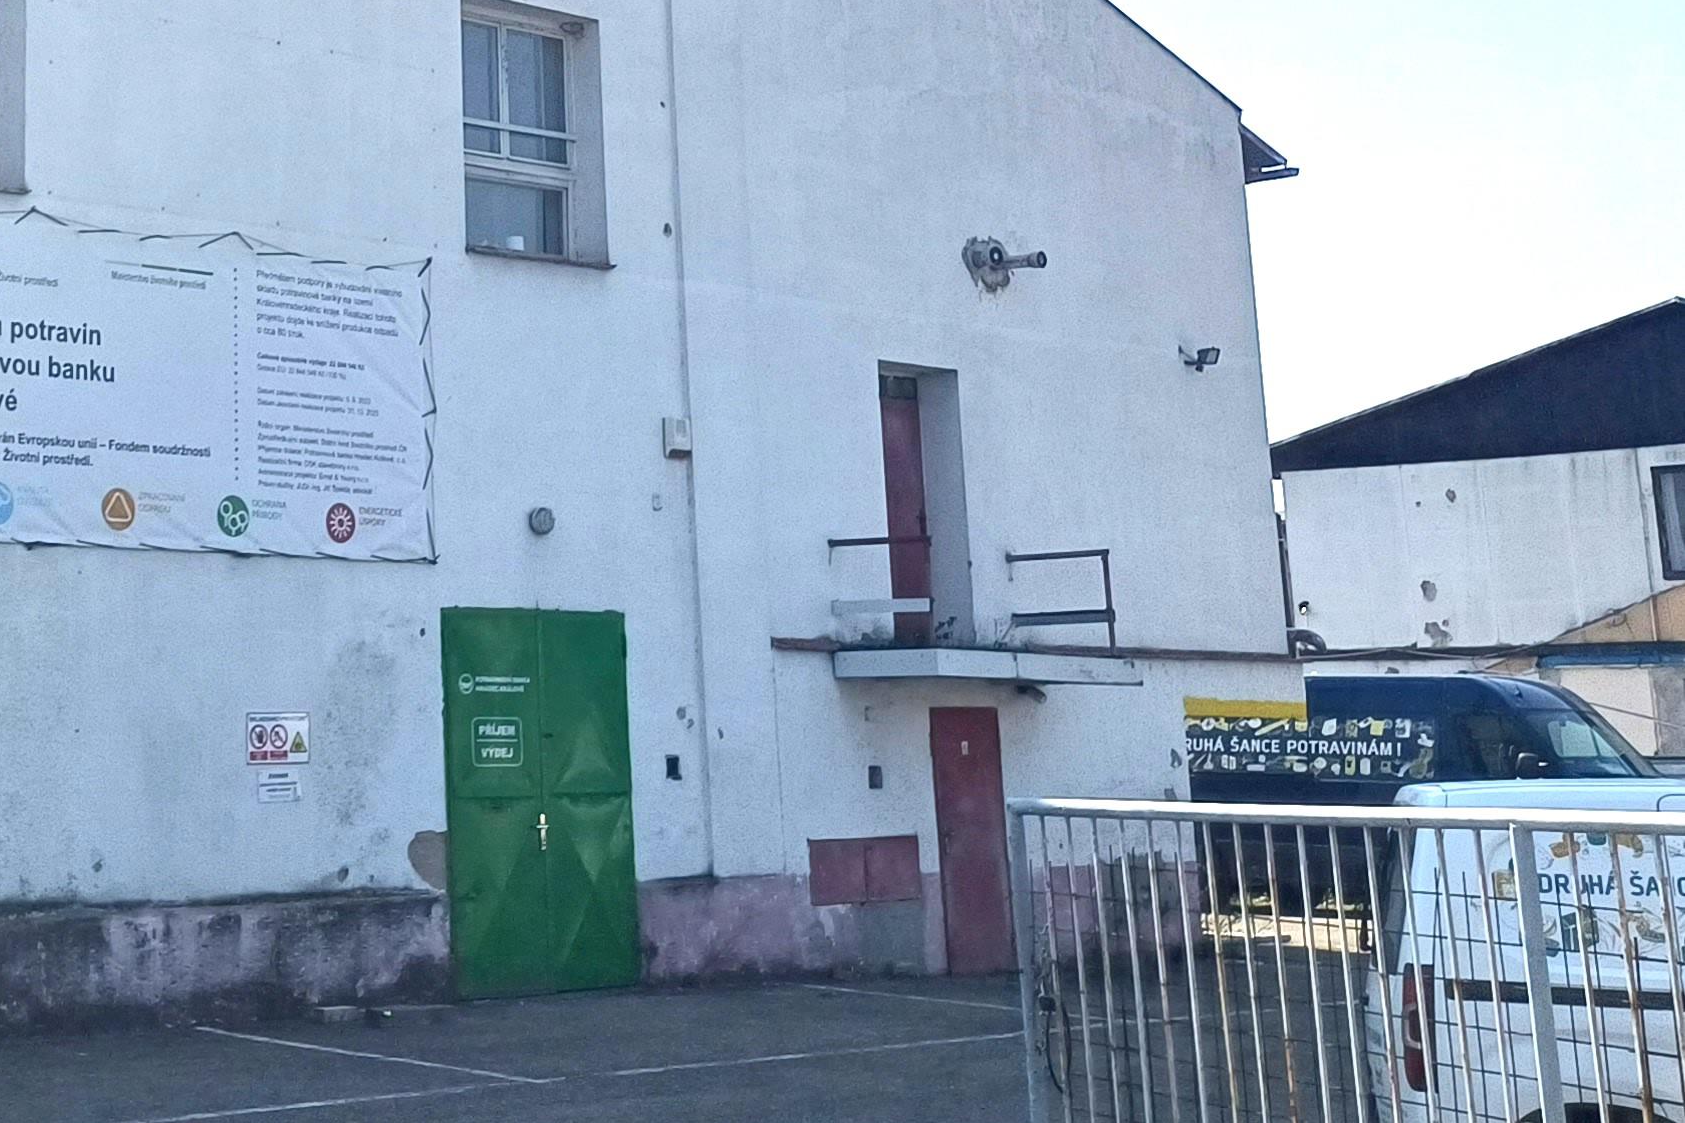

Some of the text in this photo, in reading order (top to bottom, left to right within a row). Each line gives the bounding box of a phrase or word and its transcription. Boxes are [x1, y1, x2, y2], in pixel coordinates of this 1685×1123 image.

[10, 320, 101, 346] potravin
[48, 356, 115, 383] banku
[18, 433, 75, 449] Evropskou
[108, 439, 150, 453] Fondem
[152, 443, 211, 458] soudržnosti
[3, 447, 40, 463] Životní
[42, 453, 94, 467] prostředí.
[481, 744, 513, 758] VÝDEJ
[1230, 736, 1280, 753] ŠANCE
[1286, 738, 1392, 756] POTRAVINÁM
